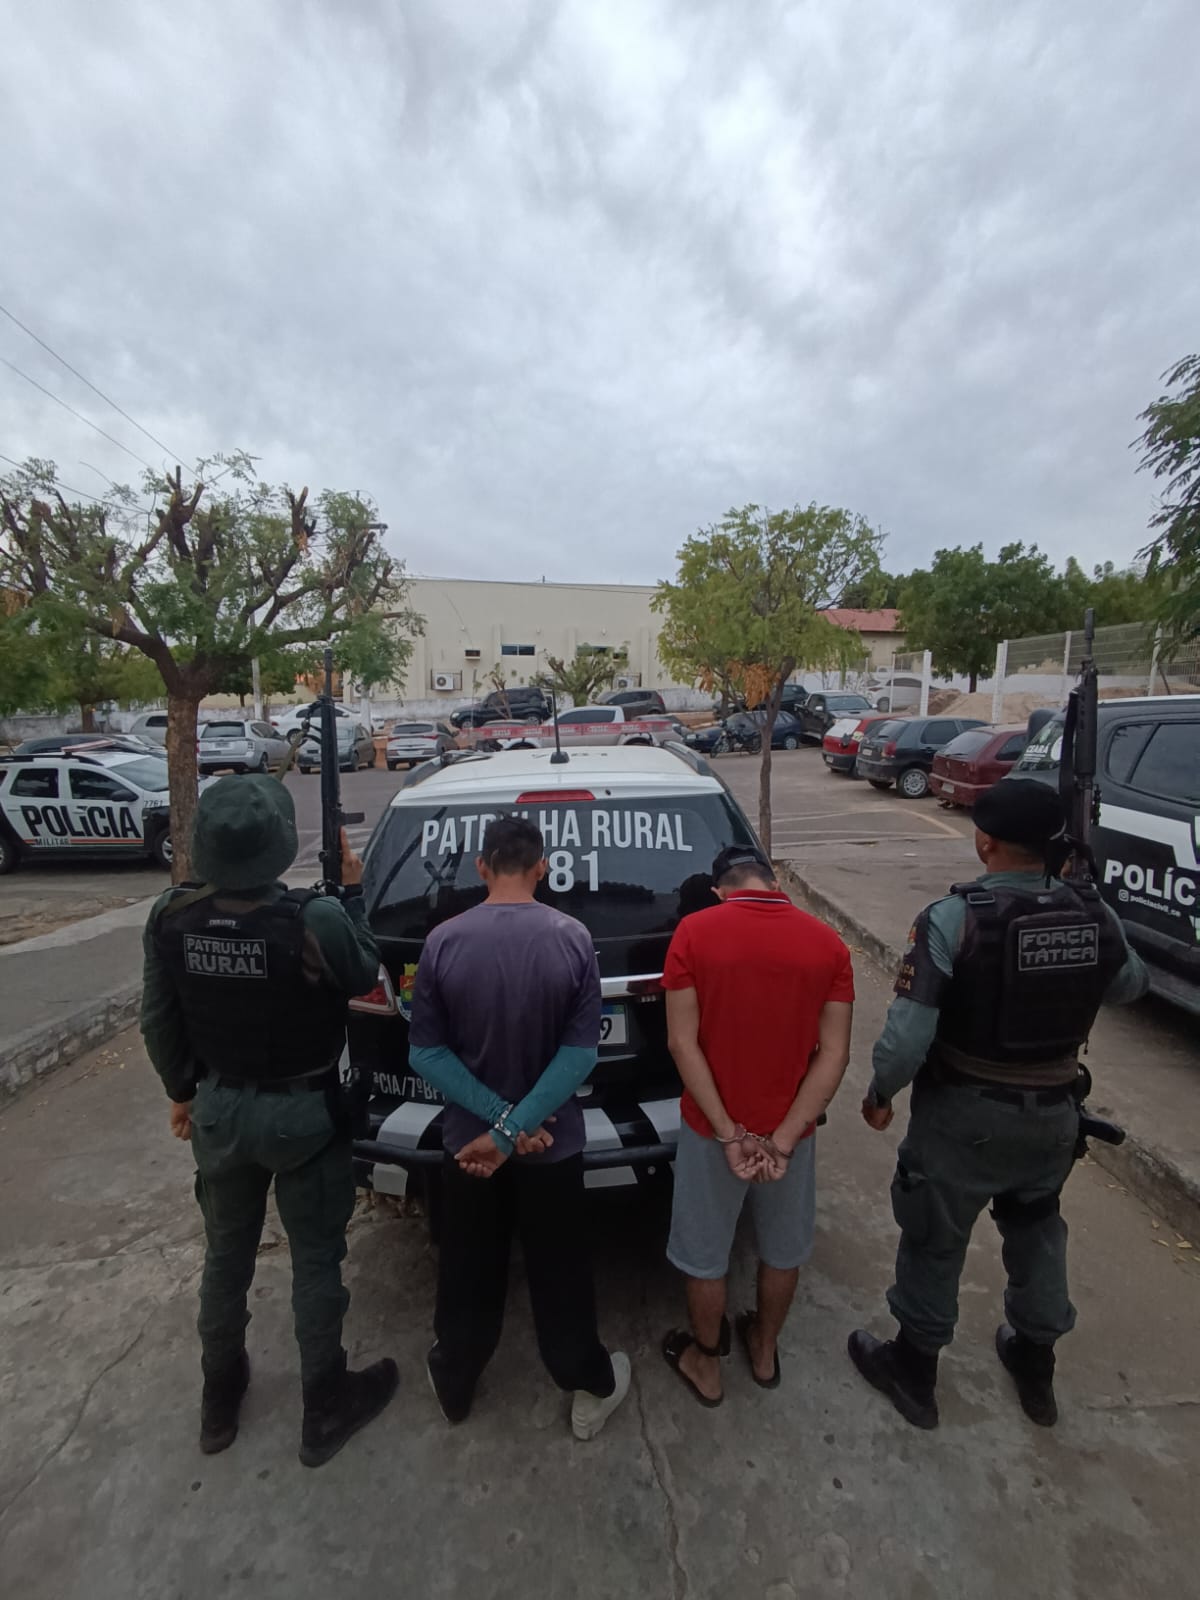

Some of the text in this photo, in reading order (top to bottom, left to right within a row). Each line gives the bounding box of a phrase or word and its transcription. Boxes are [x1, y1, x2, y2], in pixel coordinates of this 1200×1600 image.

[591, 810, 693, 852] RURAL
[541, 850, 600, 893] 81
[186, 937, 263, 956] PATRULHA
[1022, 929, 1095, 949] FORÇA
[187, 952, 264, 975] RURAL
[1023, 946, 1095, 965] TÁTICA
